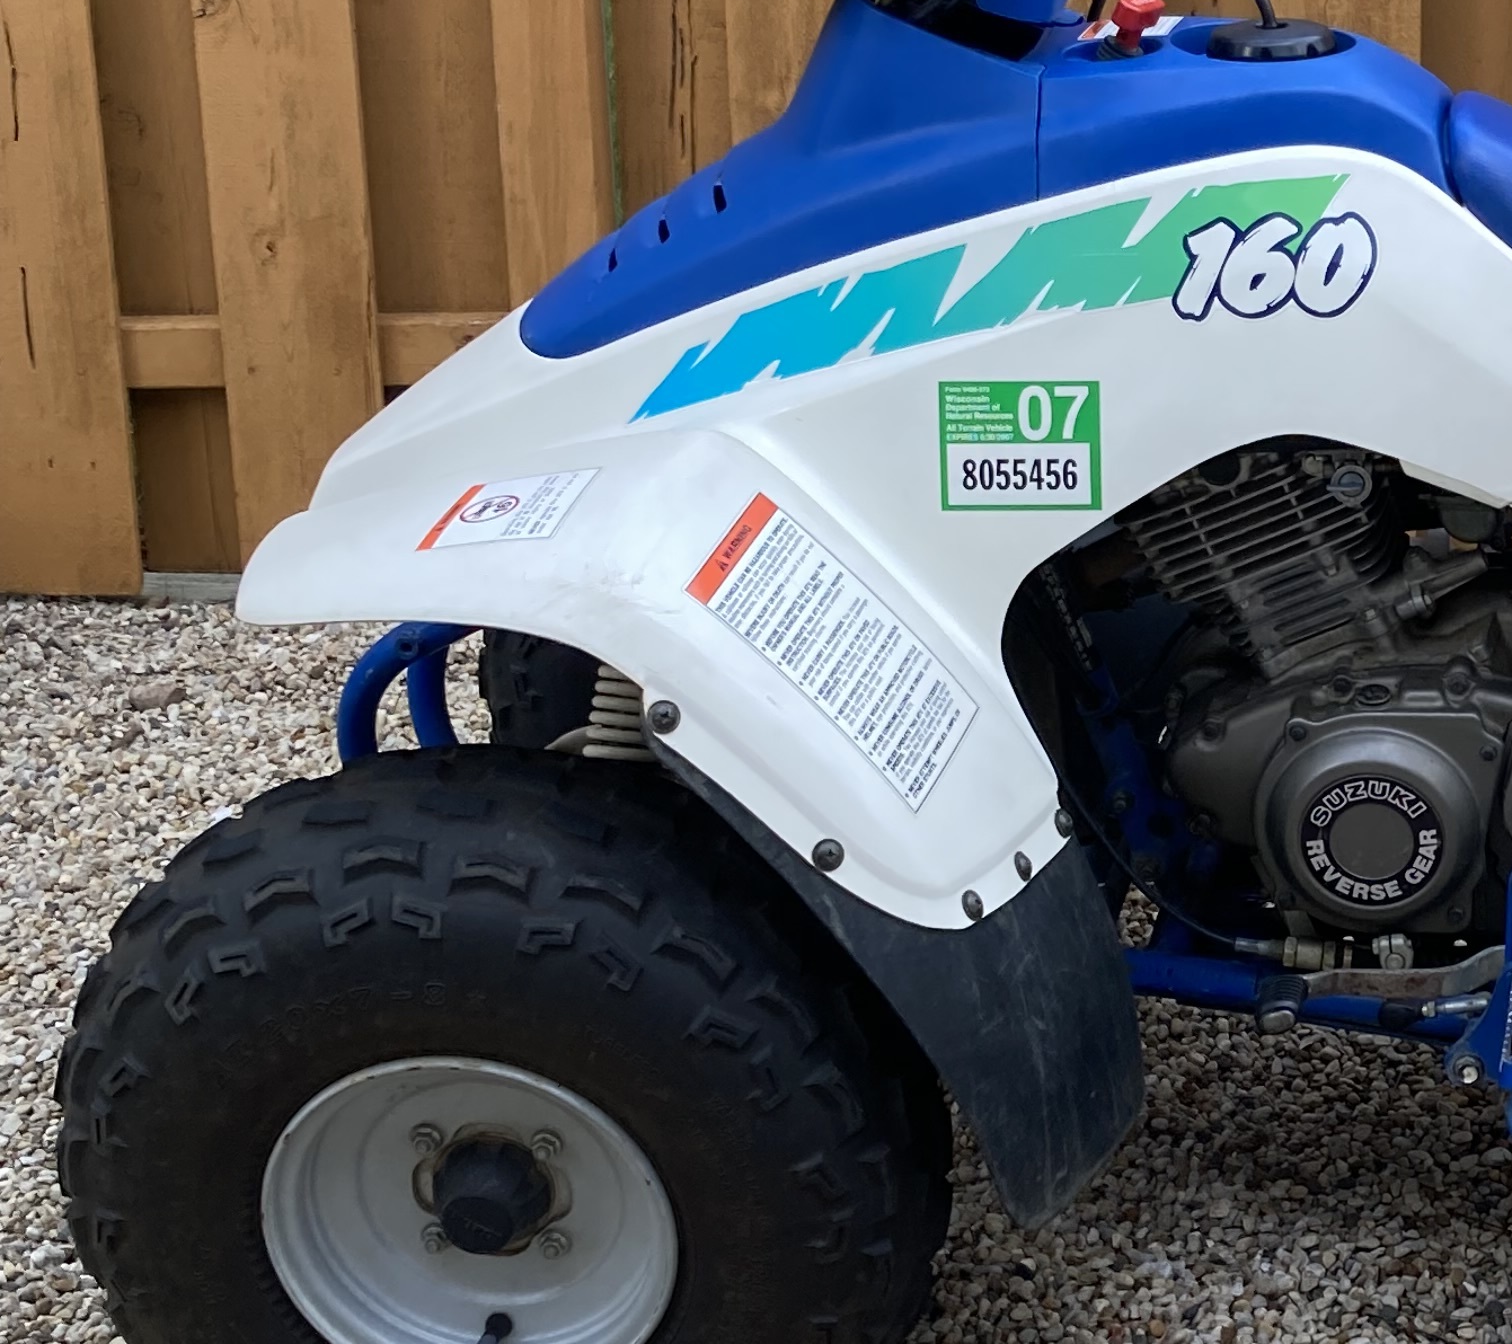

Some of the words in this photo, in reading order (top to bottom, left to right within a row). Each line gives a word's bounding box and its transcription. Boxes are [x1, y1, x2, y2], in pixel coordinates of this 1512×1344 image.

[1172, 211, 1378, 322] 160
[945, 395, 990, 403] Wisconsin
[945, 404, 990, 413] Department
[1018, 385, 1089, 441] 07
[985, 423, 1013, 432] Vehicle
[962, 458, 1078, 491] 8055456
[723, 524, 753, 562] WARNING
[1310, 780, 1427, 827] SUZUKI
[1306, 839, 1403, 900] REVERSE
[1404, 829, 1438, 884] GEAR
